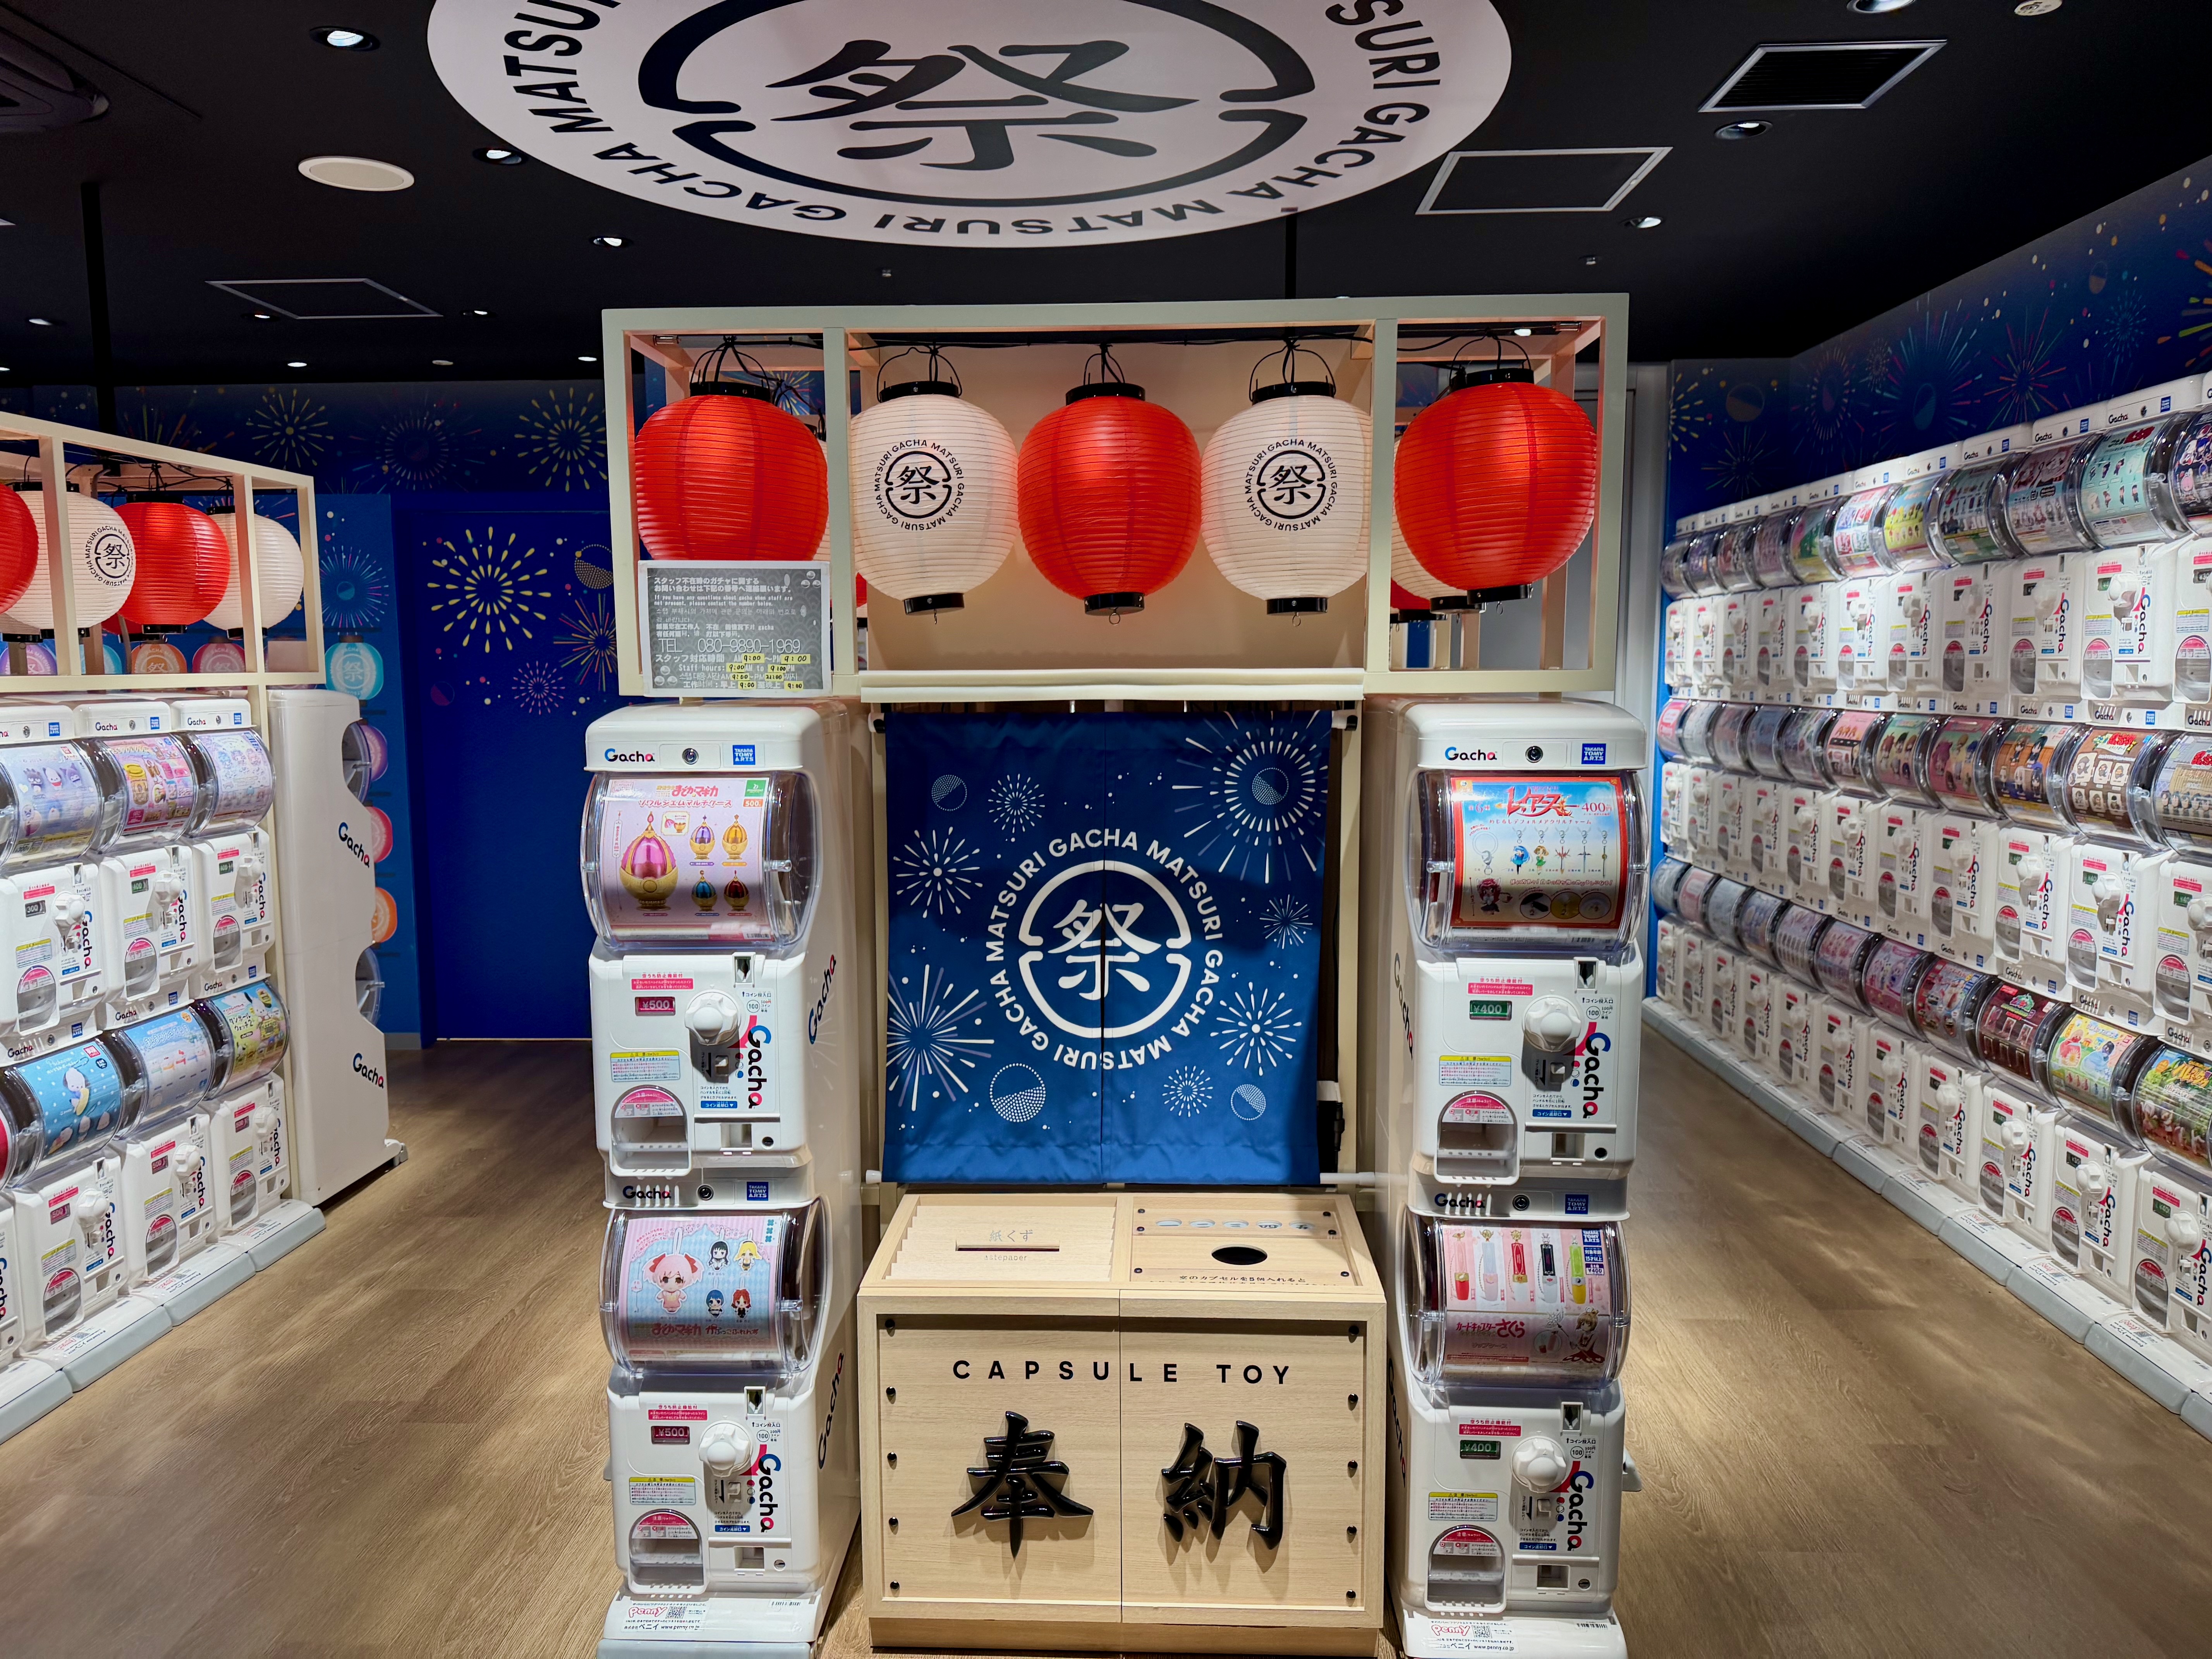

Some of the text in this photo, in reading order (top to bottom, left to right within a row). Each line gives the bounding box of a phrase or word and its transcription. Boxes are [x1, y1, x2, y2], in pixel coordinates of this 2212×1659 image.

[503, 0, 623, 132] MATSU
[766, 39, 1199, 170] 祭
[1226, 102, 1430, 199] GACHA
[593, 143, 846, 220] GACHA
[874, 199, 1224, 237] MATSURI
[2109, 413, 2128, 424] Gacha
[874, 439, 964, 531] MATSURI GACHA MATSURI GACHA MATSURI GACHA
[895, 465, 940, 504] 祭
[1245, 439, 1337, 531] MATSURI GACHA MATSURI GACHA MATSURI GACHA
[1269, 465, 1315, 504] 祭
[85, 531, 98, 558] MATSURI
[103, 543, 126, 569] 祭
[658, 639, 800, 653] TEL 080-9890-1969
[2138, 593, 2150, 654] Gacha
[95, 722, 118, 731] Gacha
[187, 717, 206, 726] Gacha
[604, 748, 655, 763] Gacha
[1445, 747, 1497, 761] Gacha
[338, 822, 370, 868] Gacha
[986, 828, 1223, 1070] MATSURI GACHA MATSURI GACHA MATSURI GACHA
[1048, 899, 1161, 1000] 祭
[2121, 901, 2134, 957] Gacha
[809, 954, 836, 1044] Gacha
[1394, 952, 1413, 1061] Gacha
[2168, 1028, 2190, 1043] Gacha
[352, 1052, 385, 1089] Gacha
[747, 1025, 771, 1109] Gacha
[1583, 1032, 1611, 1118] Gacha
[622, 1185, 671, 1199] Gacha
[1434, 1193, 1485, 1209] Gacha
[989, 1230, 1033, 1242] 紙くず
[953, 1360, 1290, 1385] CAPSULE TOY
[818, 1353, 844, 1469] Gacha
[758, 1454, 781, 1533] Gacha
[1568, 1471, 1594, 1551] Gacha
